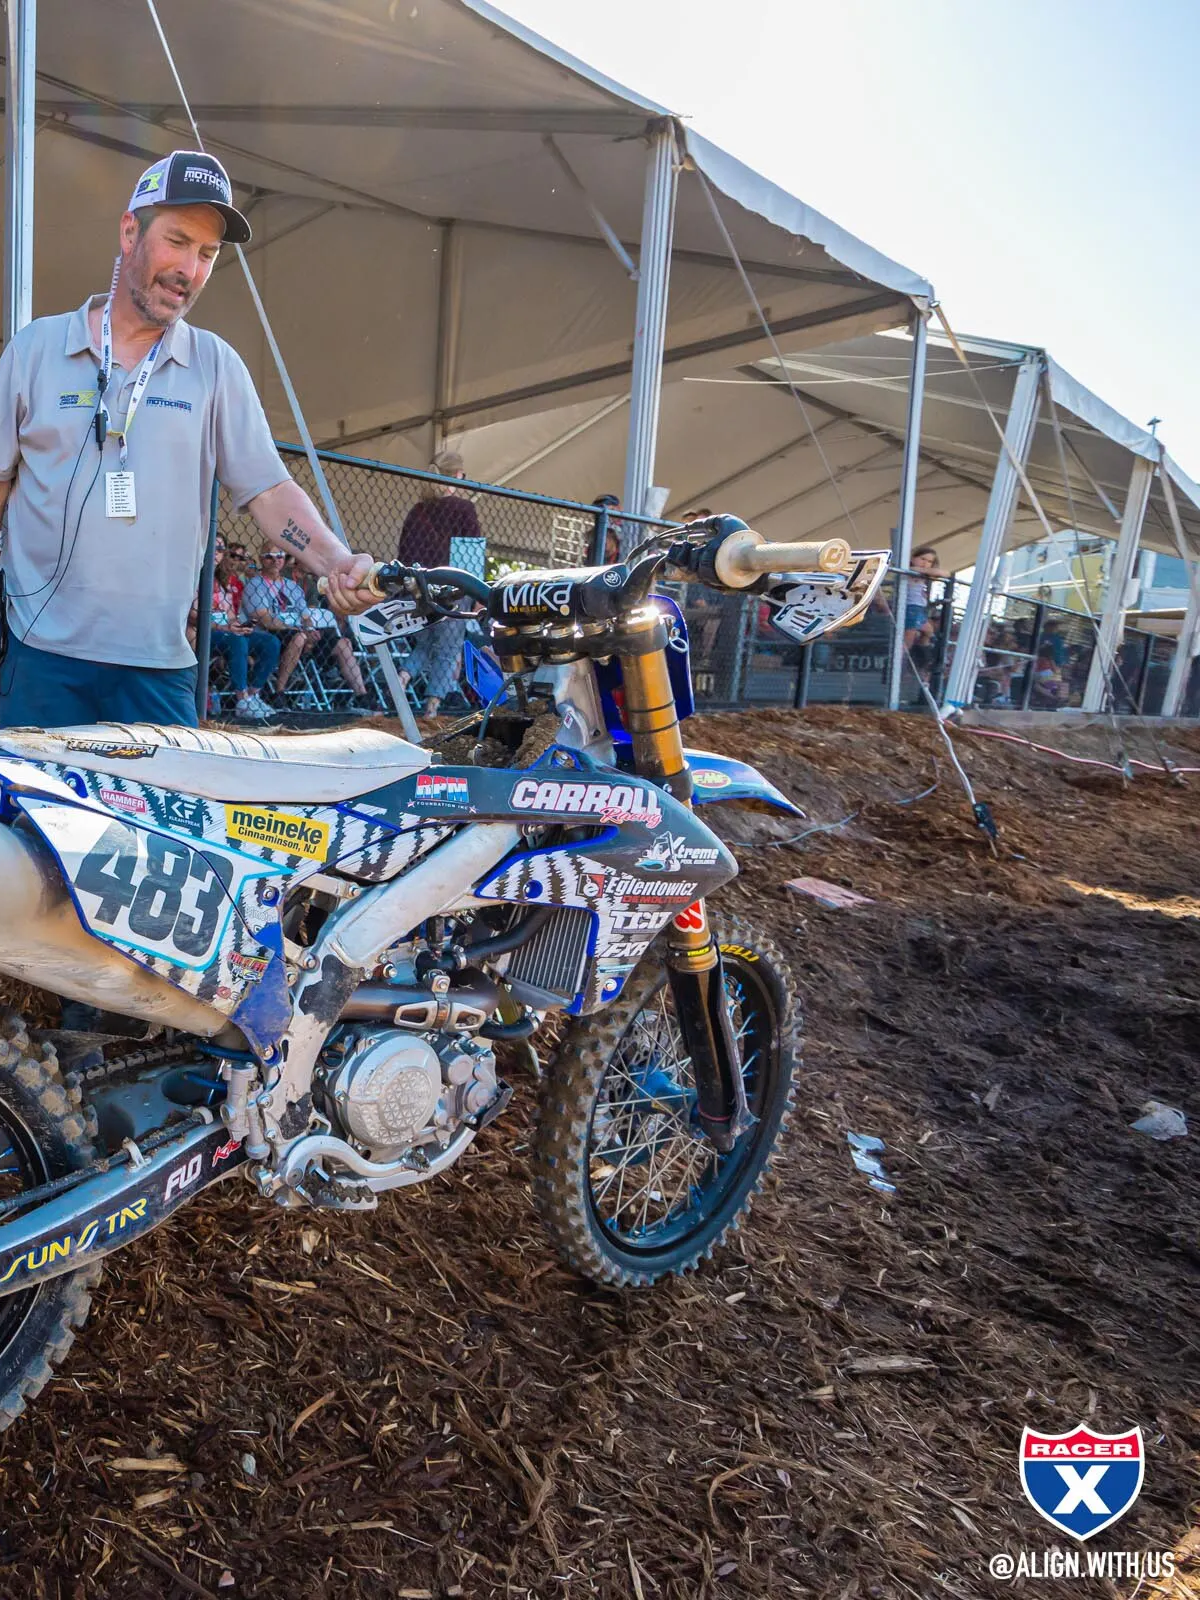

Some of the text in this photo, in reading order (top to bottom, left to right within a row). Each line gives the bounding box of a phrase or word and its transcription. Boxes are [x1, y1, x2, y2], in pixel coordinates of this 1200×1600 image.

[146, 399, 192, 411] MOTOCROSS
[415, 774, 469, 803] RPM
[511, 780, 662, 815] CARROLL
[103, 791, 144, 809] HAMMER
[170, 801, 197, 820] KF
[416, 801, 457, 809] FOUNDATION
[232, 810, 323, 845] meineke
[599, 806, 663, 829] Racing
[238, 826, 317, 854] Cinnaminson, NJ
[74, 822, 234, 957] 483
[604, 877, 698, 896] Eglentowicz
[621, 896, 691, 904] DEMOLITION
